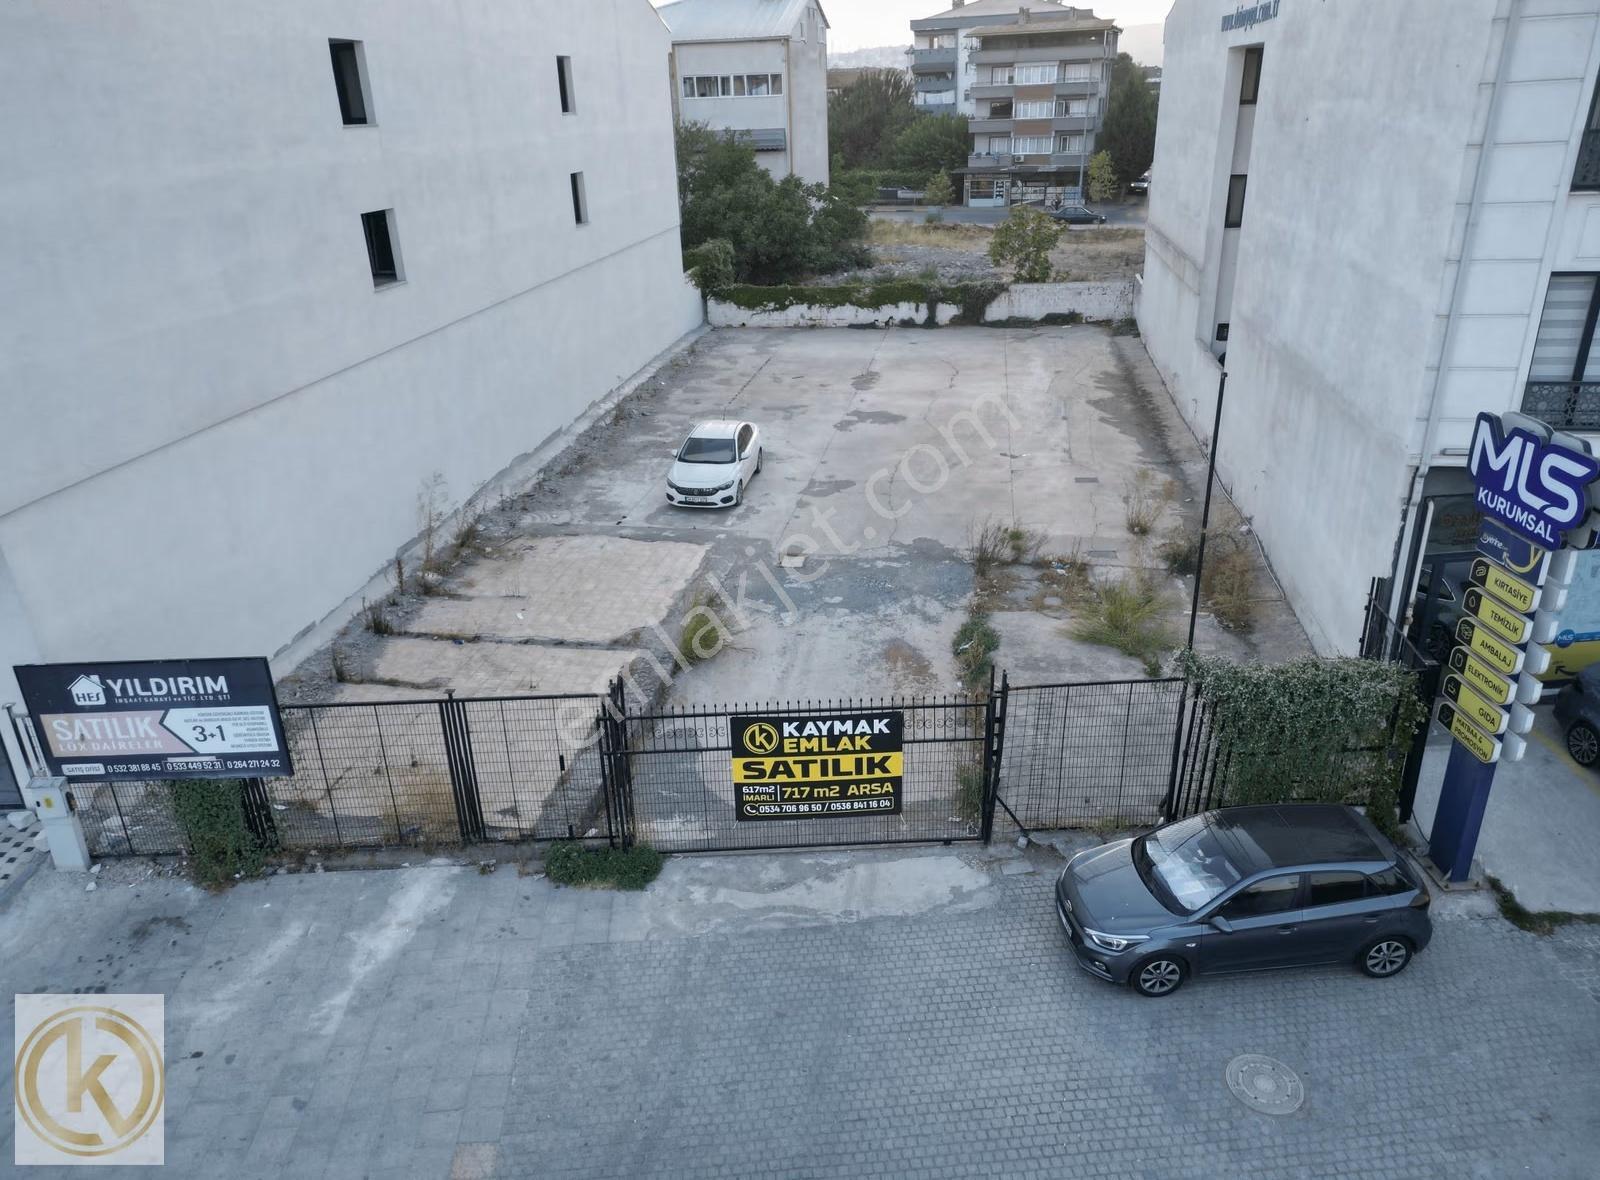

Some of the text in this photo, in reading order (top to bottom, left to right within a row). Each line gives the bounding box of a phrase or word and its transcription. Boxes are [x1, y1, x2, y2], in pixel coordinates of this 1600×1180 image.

[1470, 420, 1591, 523] MLS
[1477, 487, 1554, 543] KURUMSAL
[1494, 577, 1528, 604] KIRTASİYE
[1490, 610, 1519, 635] TEMİZLİK
[1480, 640, 1511, 667] AMBALAJ
[106, 676, 228, 697] YILDIRIM
[1468, 664, 1504, 696] ELEKTRONİK
[51, 717, 158, 741] SATILIK
[783, 719, 891, 737] KAYMAK
[1478, 707, 1496, 727] GIDA
[192, 724, 226, 743] 3+1
[783, 735, 872, 753] EMLAK
[1454, 726, 1488, 759] PROMOSYON
[742, 755, 892, 780] SATILIK
[742, 785, 775, 793] 617m2
[782, 782, 894, 799] 717 m2 ARSA
[759, 805, 780, 813] 0534
[799, 804, 809, 812] 96
[831, 802, 851, 810] 0536
[853, 801, 867, 809] 841
[869, 800, 878, 808] 16
[879, 799, 890, 807] 04
